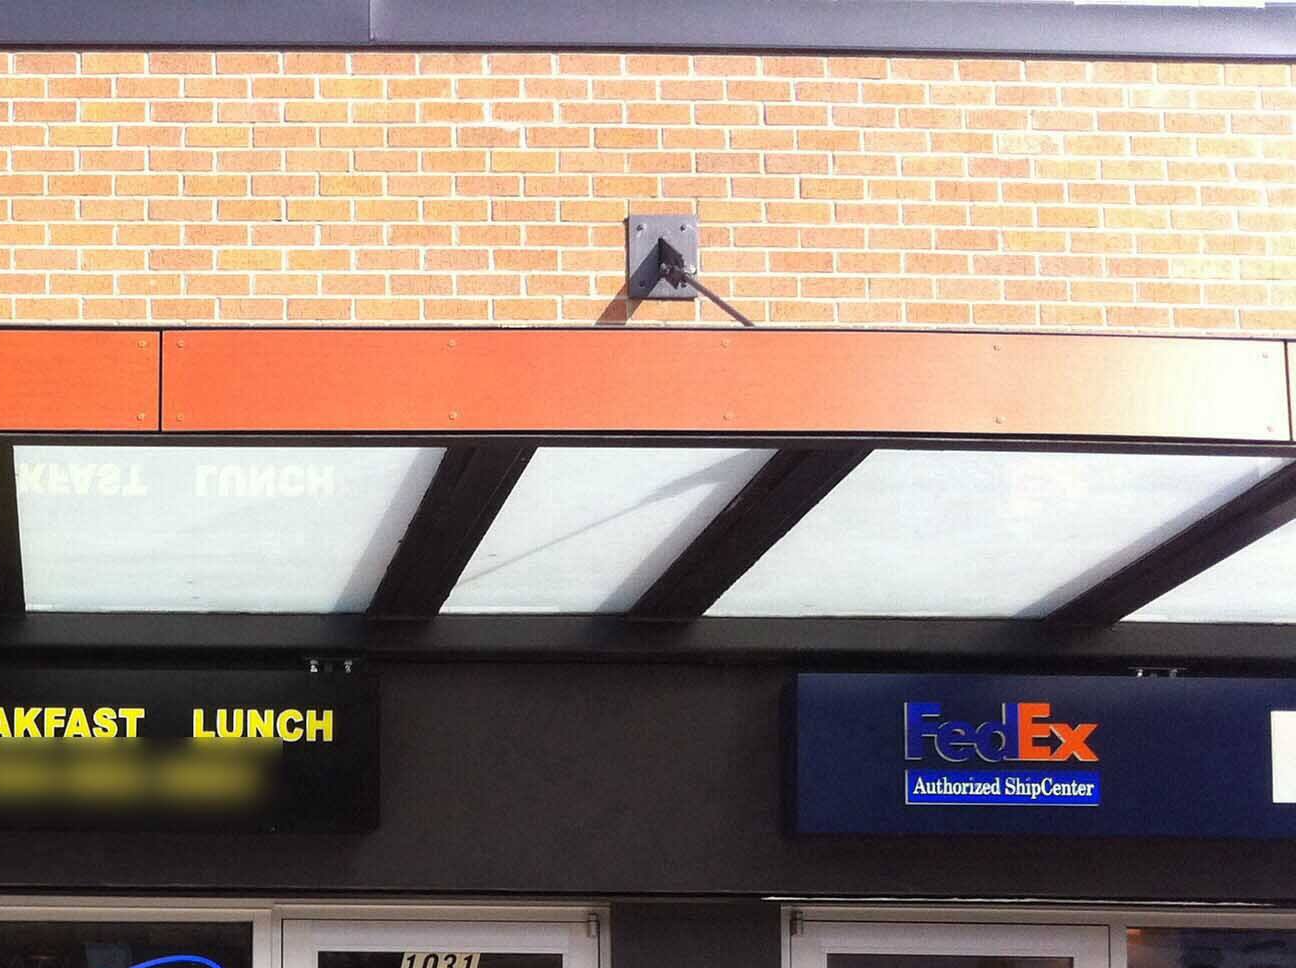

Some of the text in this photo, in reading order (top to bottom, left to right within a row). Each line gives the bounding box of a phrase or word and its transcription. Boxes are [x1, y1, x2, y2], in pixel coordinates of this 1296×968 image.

[192, 708, 334, 742] LUNCH
[904, 701, 1099, 762] FedEx
[912, 776, 1095, 799] Authorized ShipCenter
